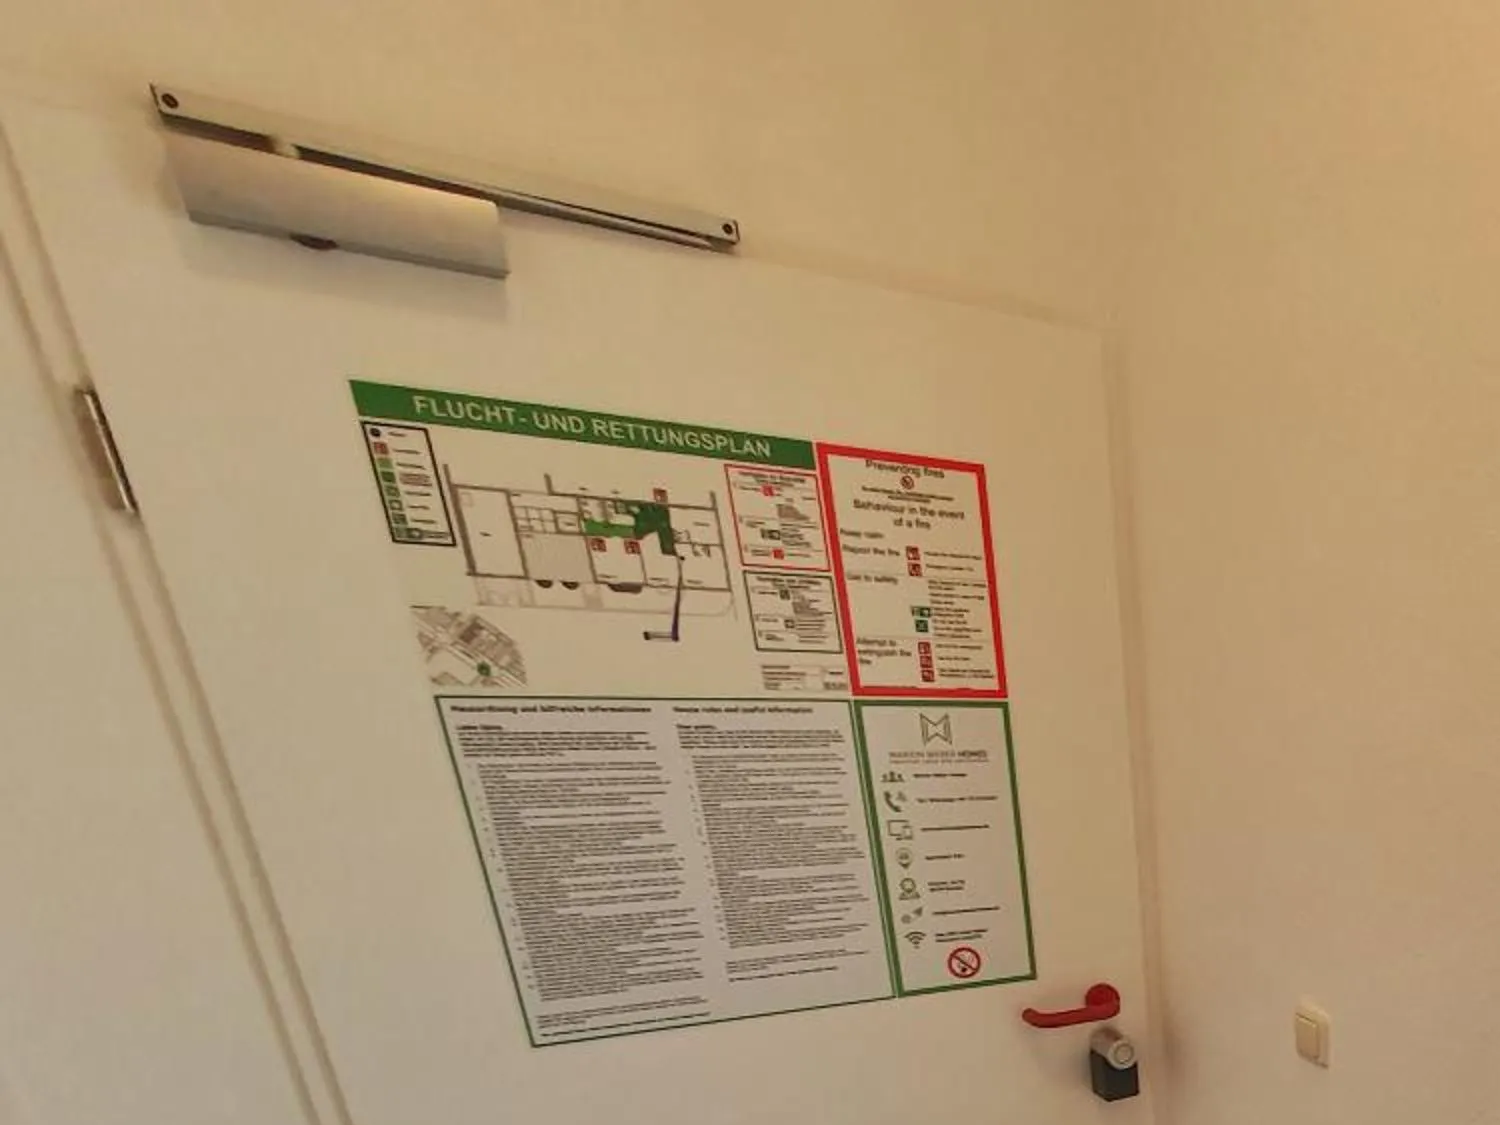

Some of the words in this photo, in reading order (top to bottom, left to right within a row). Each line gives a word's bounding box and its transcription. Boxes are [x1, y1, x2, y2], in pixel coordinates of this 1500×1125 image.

[412, 395, 528, 425] FLUCHT-
[532, 411, 585, 433] UND
[591, 418, 771, 457] RETTUNGSPLAN
